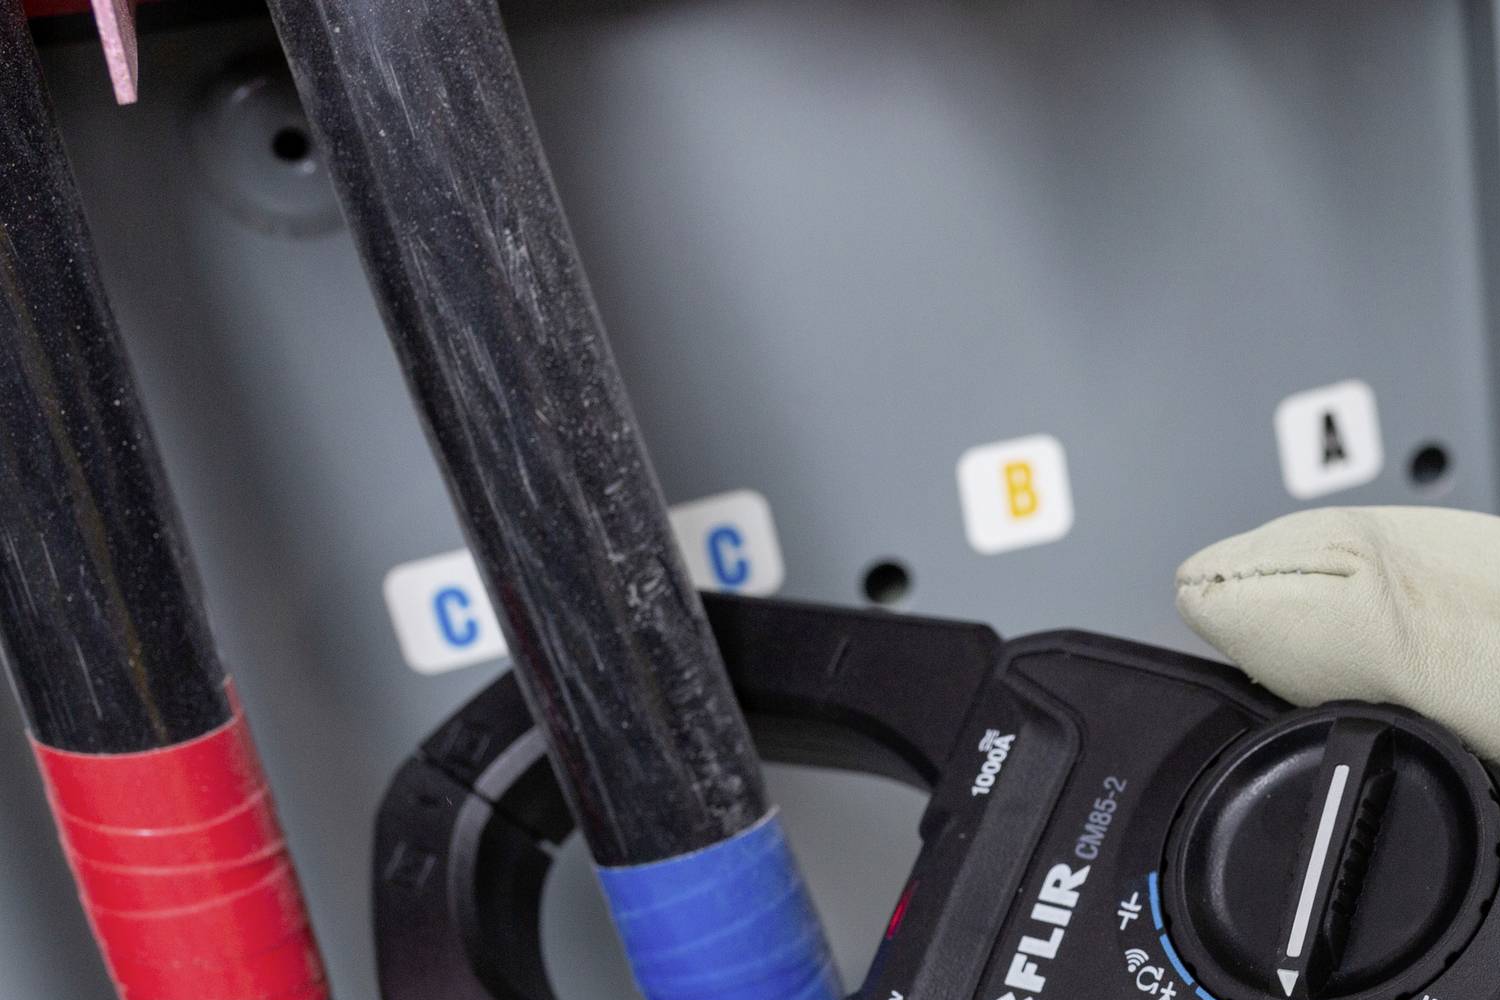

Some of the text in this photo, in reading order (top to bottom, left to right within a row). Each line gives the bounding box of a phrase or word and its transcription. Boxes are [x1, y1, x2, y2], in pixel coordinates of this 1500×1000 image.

[1320, 411, 1347, 465] A
[1004, 461, 1039, 518] B
[706, 525, 749, 588] C
[433, 586, 478, 647] C
[1004, 776, 1127, 993] FLIR CM85-2
